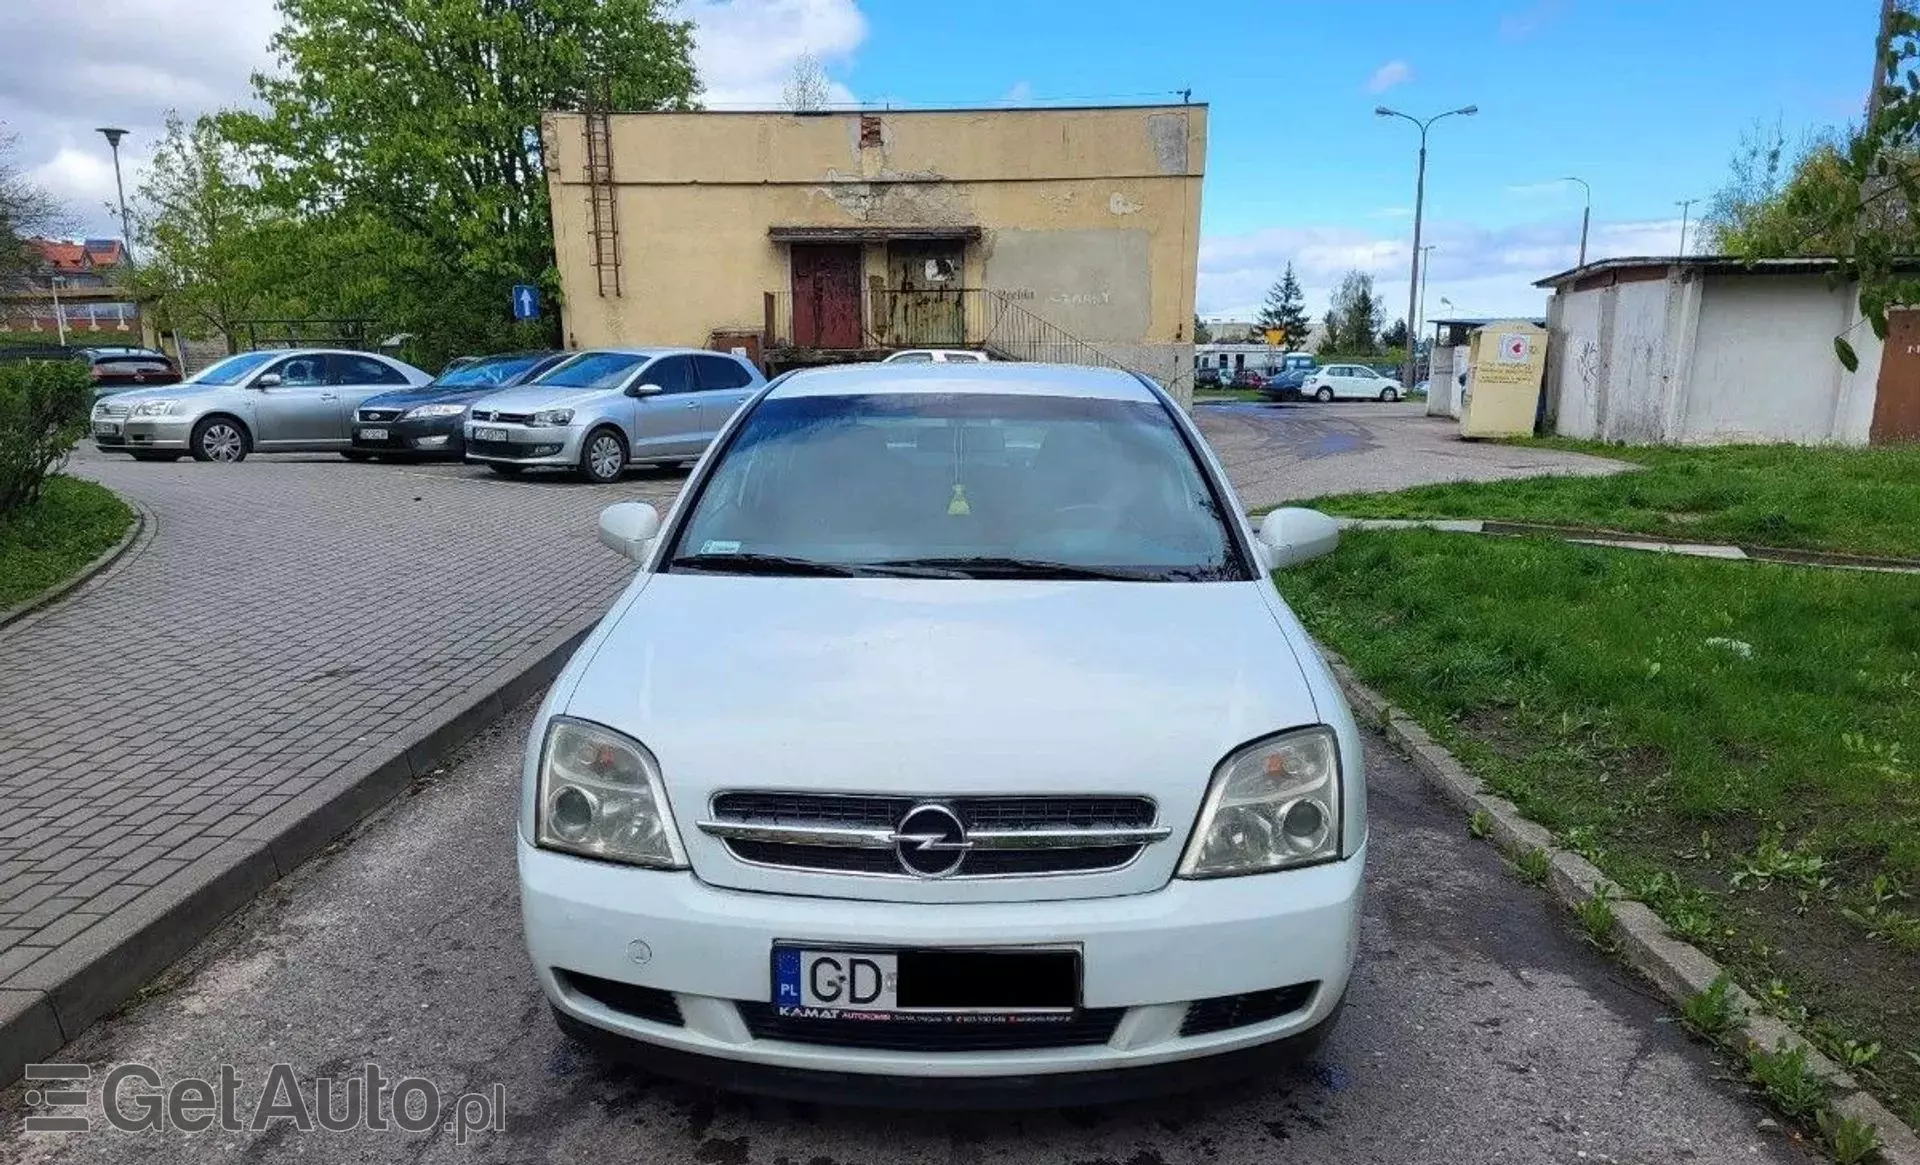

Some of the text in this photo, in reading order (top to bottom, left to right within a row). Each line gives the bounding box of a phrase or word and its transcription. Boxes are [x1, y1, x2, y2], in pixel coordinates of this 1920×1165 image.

[810, 956, 883, 1004] GD
[781, 983, 798, 996] PL
[779, 1006, 840, 1019] KAMAT
